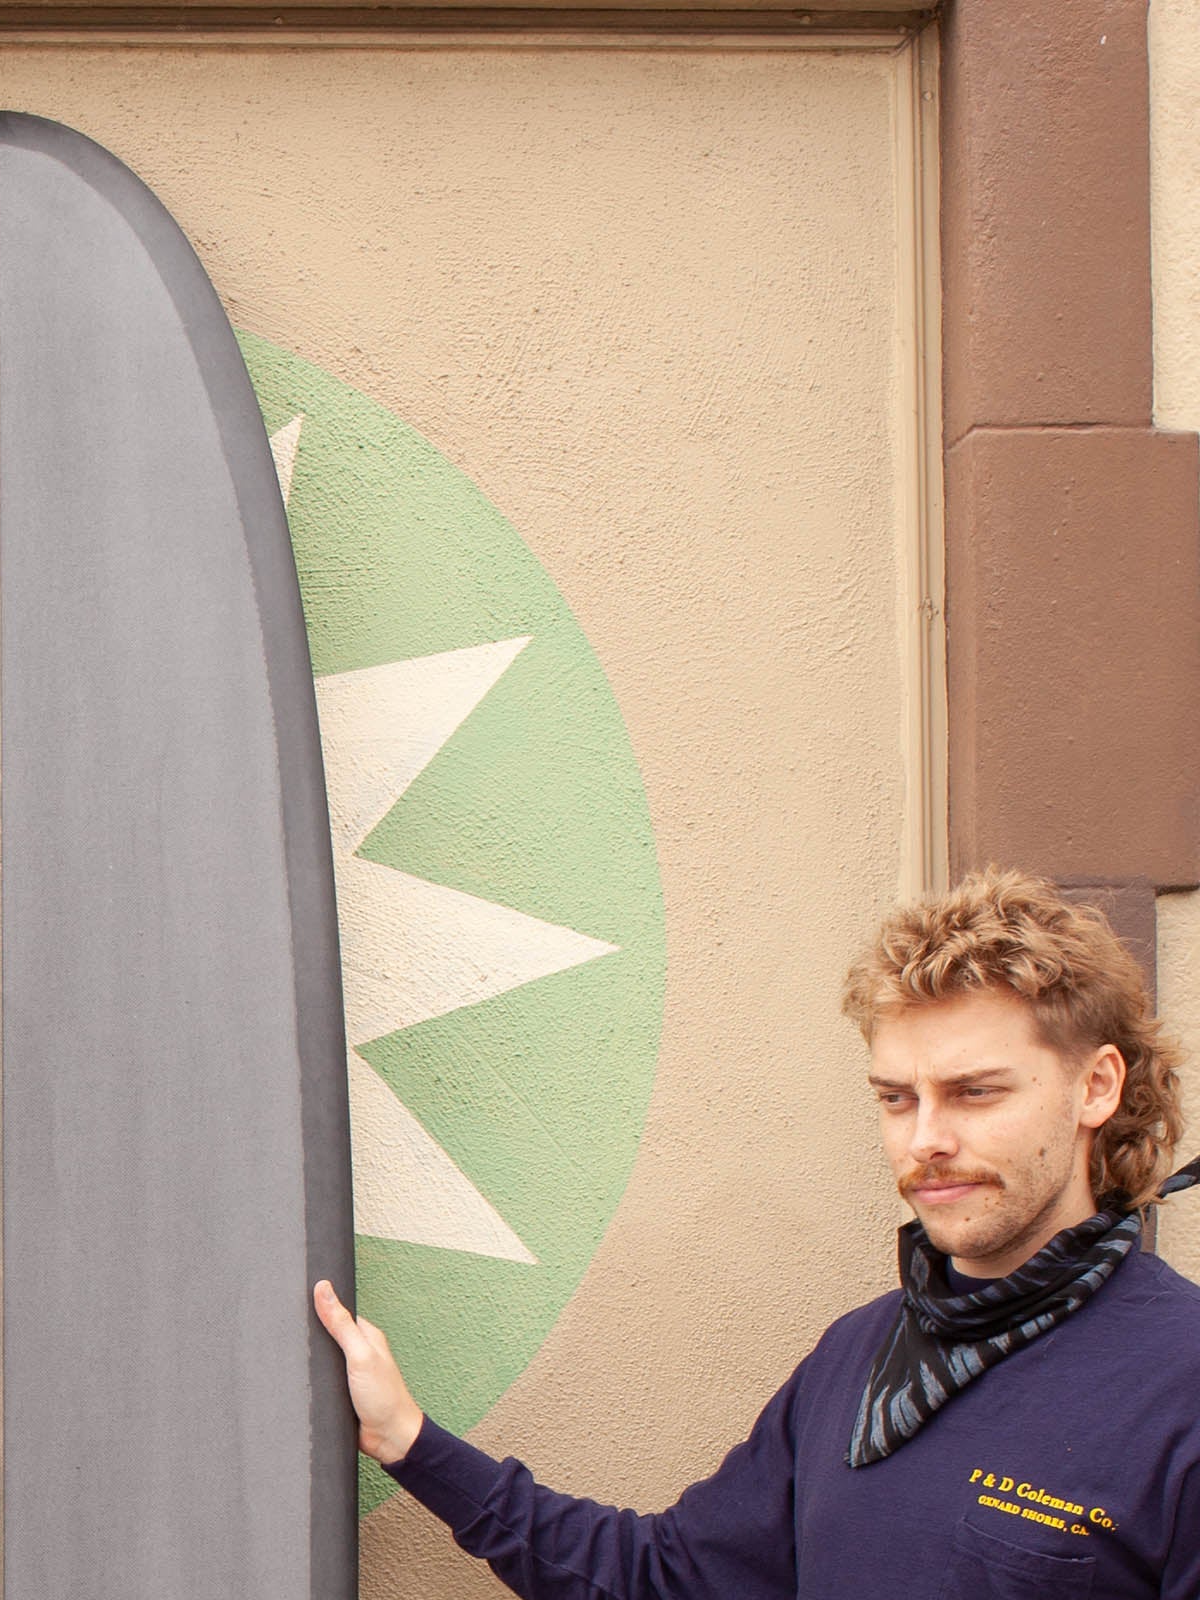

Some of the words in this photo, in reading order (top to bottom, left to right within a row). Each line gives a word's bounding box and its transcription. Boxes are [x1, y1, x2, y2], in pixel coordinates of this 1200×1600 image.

[969, 1469, 983, 1483] P
[983, 1473, 997, 1488] &
[998, 1477, 1014, 1492] D
[1016, 1483, 1085, 1516] Coleman
